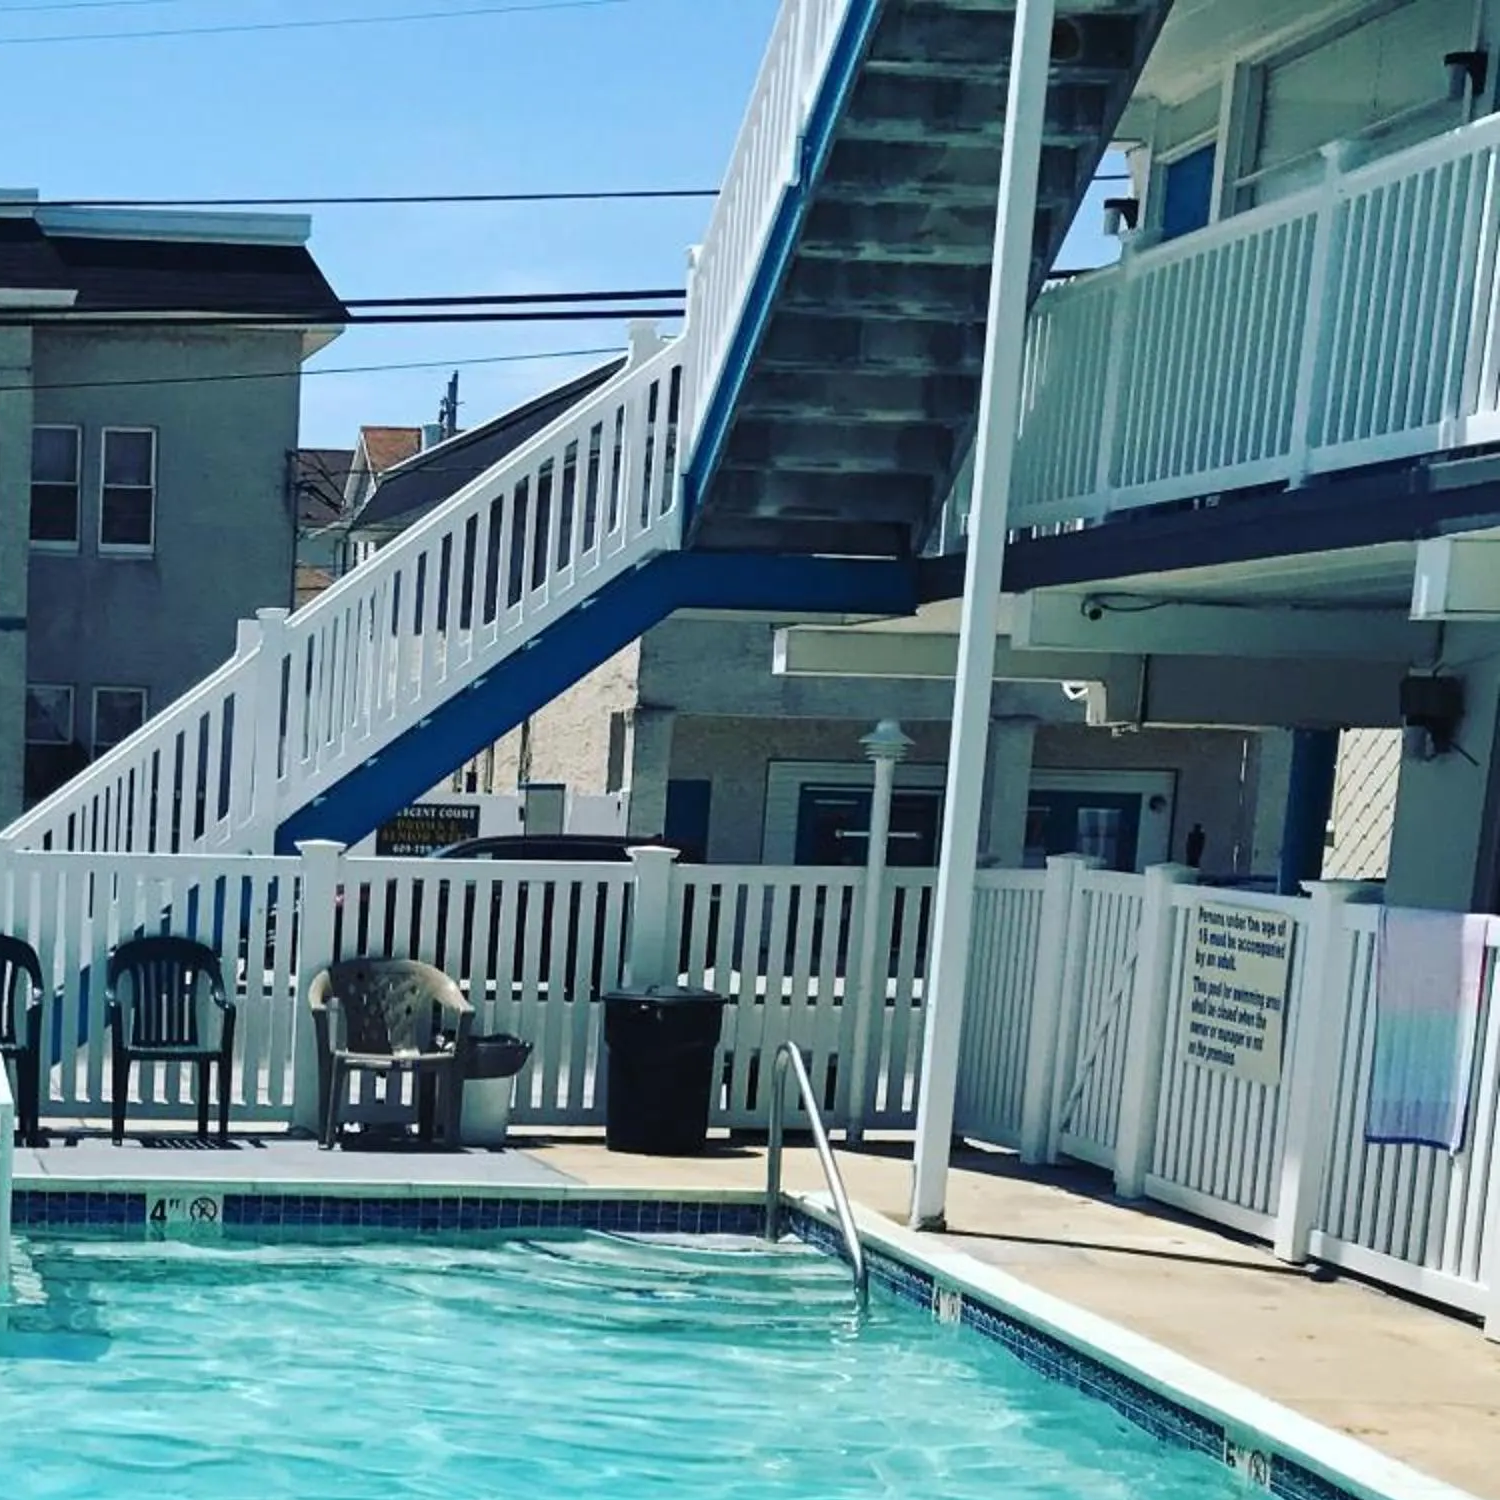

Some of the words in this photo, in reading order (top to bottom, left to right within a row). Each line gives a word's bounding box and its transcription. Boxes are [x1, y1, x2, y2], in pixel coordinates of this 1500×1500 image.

[438, 808, 476, 819] COURT
[1261, 920, 1276, 938] age
[1277, 920, 1287, 937] of
[1195, 947, 1205, 968] by
[1206, 953, 1216, 967] an
[1237, 937, 1286, 959] accompanied
